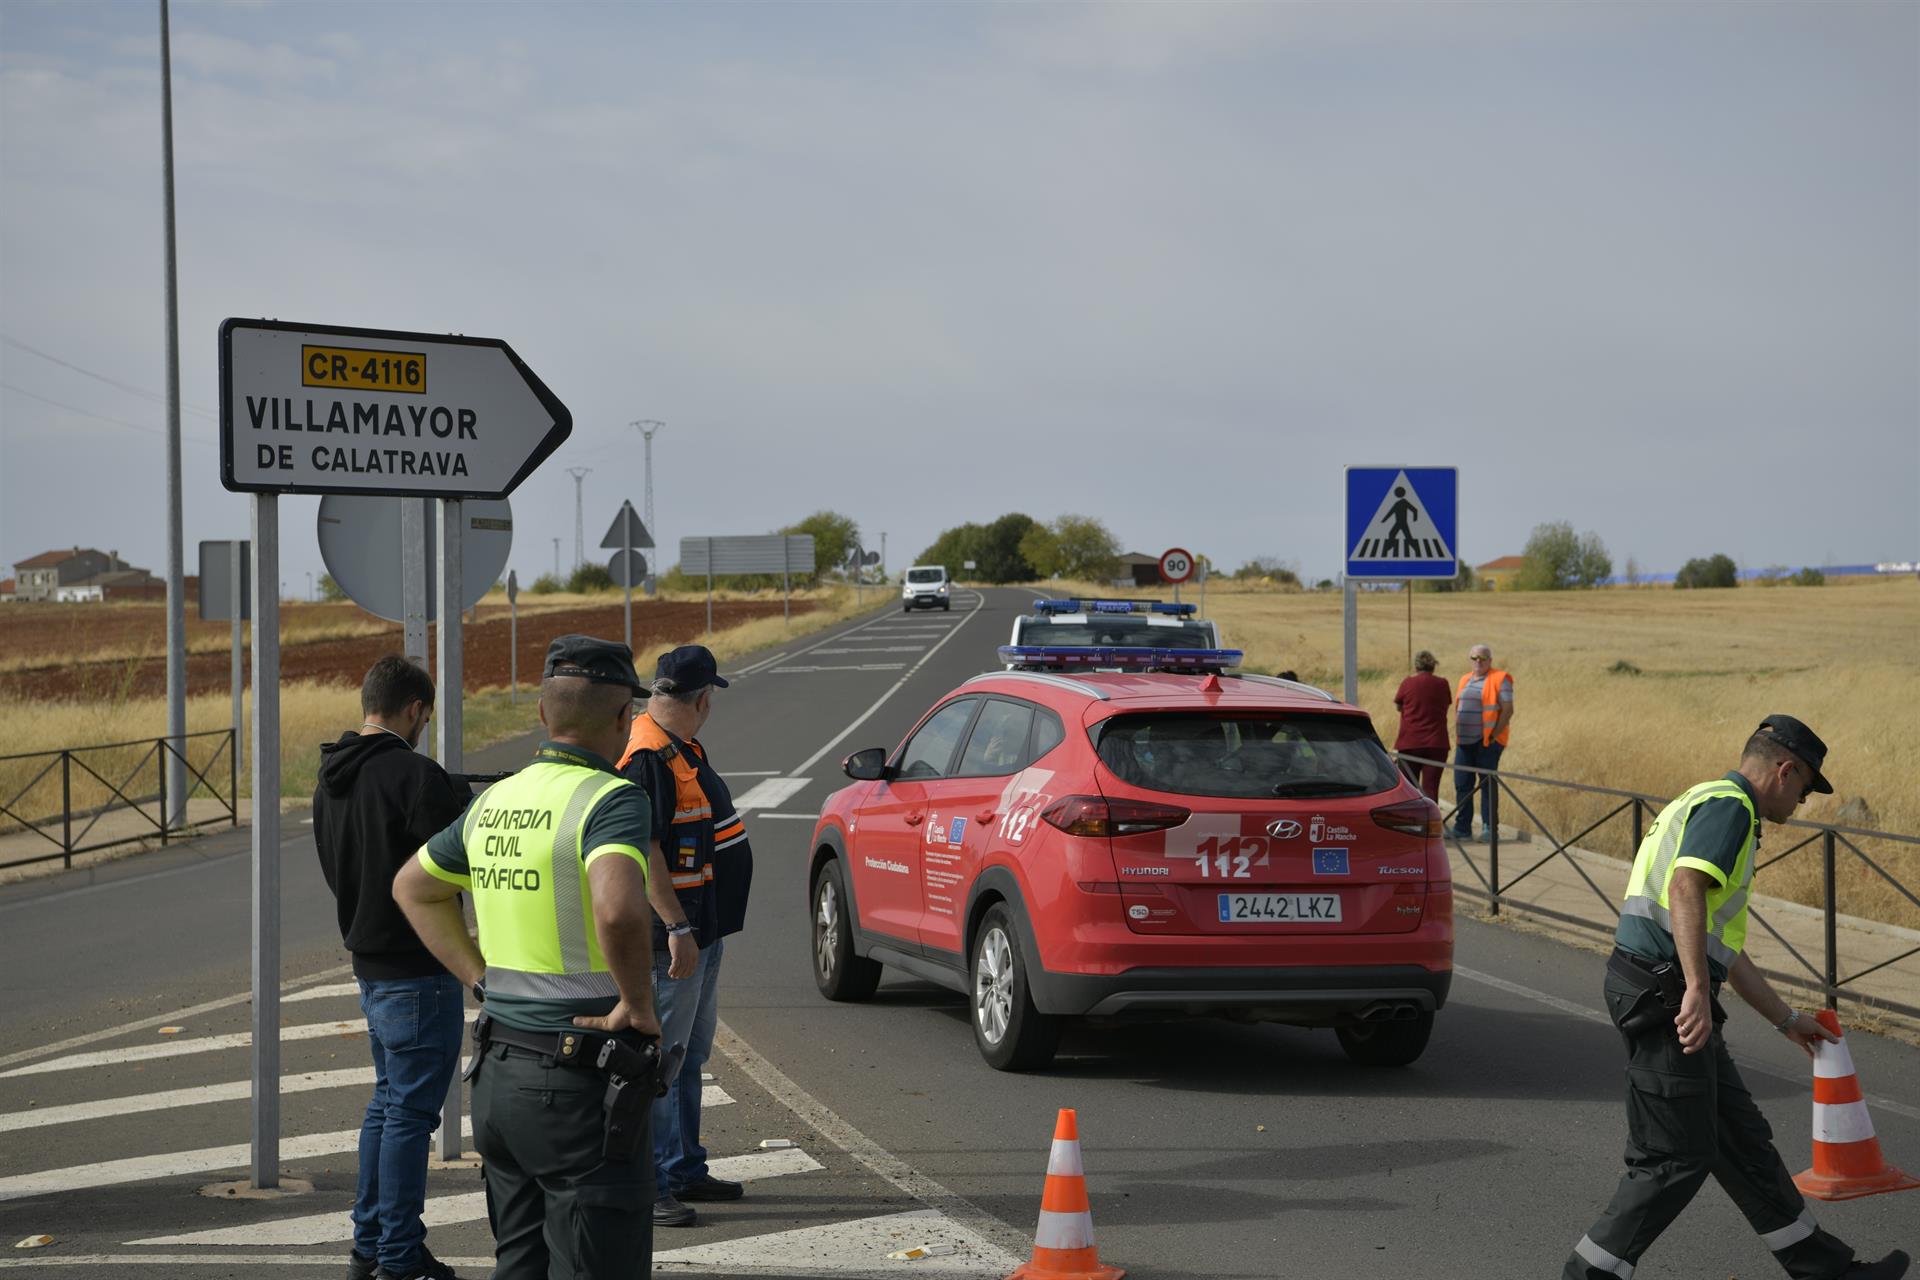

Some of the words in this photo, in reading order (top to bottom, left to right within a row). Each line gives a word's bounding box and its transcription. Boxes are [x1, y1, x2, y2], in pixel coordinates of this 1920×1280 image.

[308, 353, 420, 385] CR-4116
[246, 396, 478, 440] VILLAMAYOR
[257, 444, 294, 470] DE
[311, 446, 469, 477] CALATRAVA
[1167, 560, 1187, 572] 90
[478, 808, 552, 830] GUARDIA
[999, 812, 1028, 841] 112
[1326, 826, 1349, 834] Castilla
[485, 835, 522, 857] CIVIL
[471, 863, 540, 891] TRÁFICO
[1121, 867, 1169, 875] HYUNDAI
[1195, 855, 1251, 878] 112
[1377, 866, 1424, 874] TUCSON
[1235, 897, 1290, 919] 2442
[1296, 897, 1336, 919] LKZ
